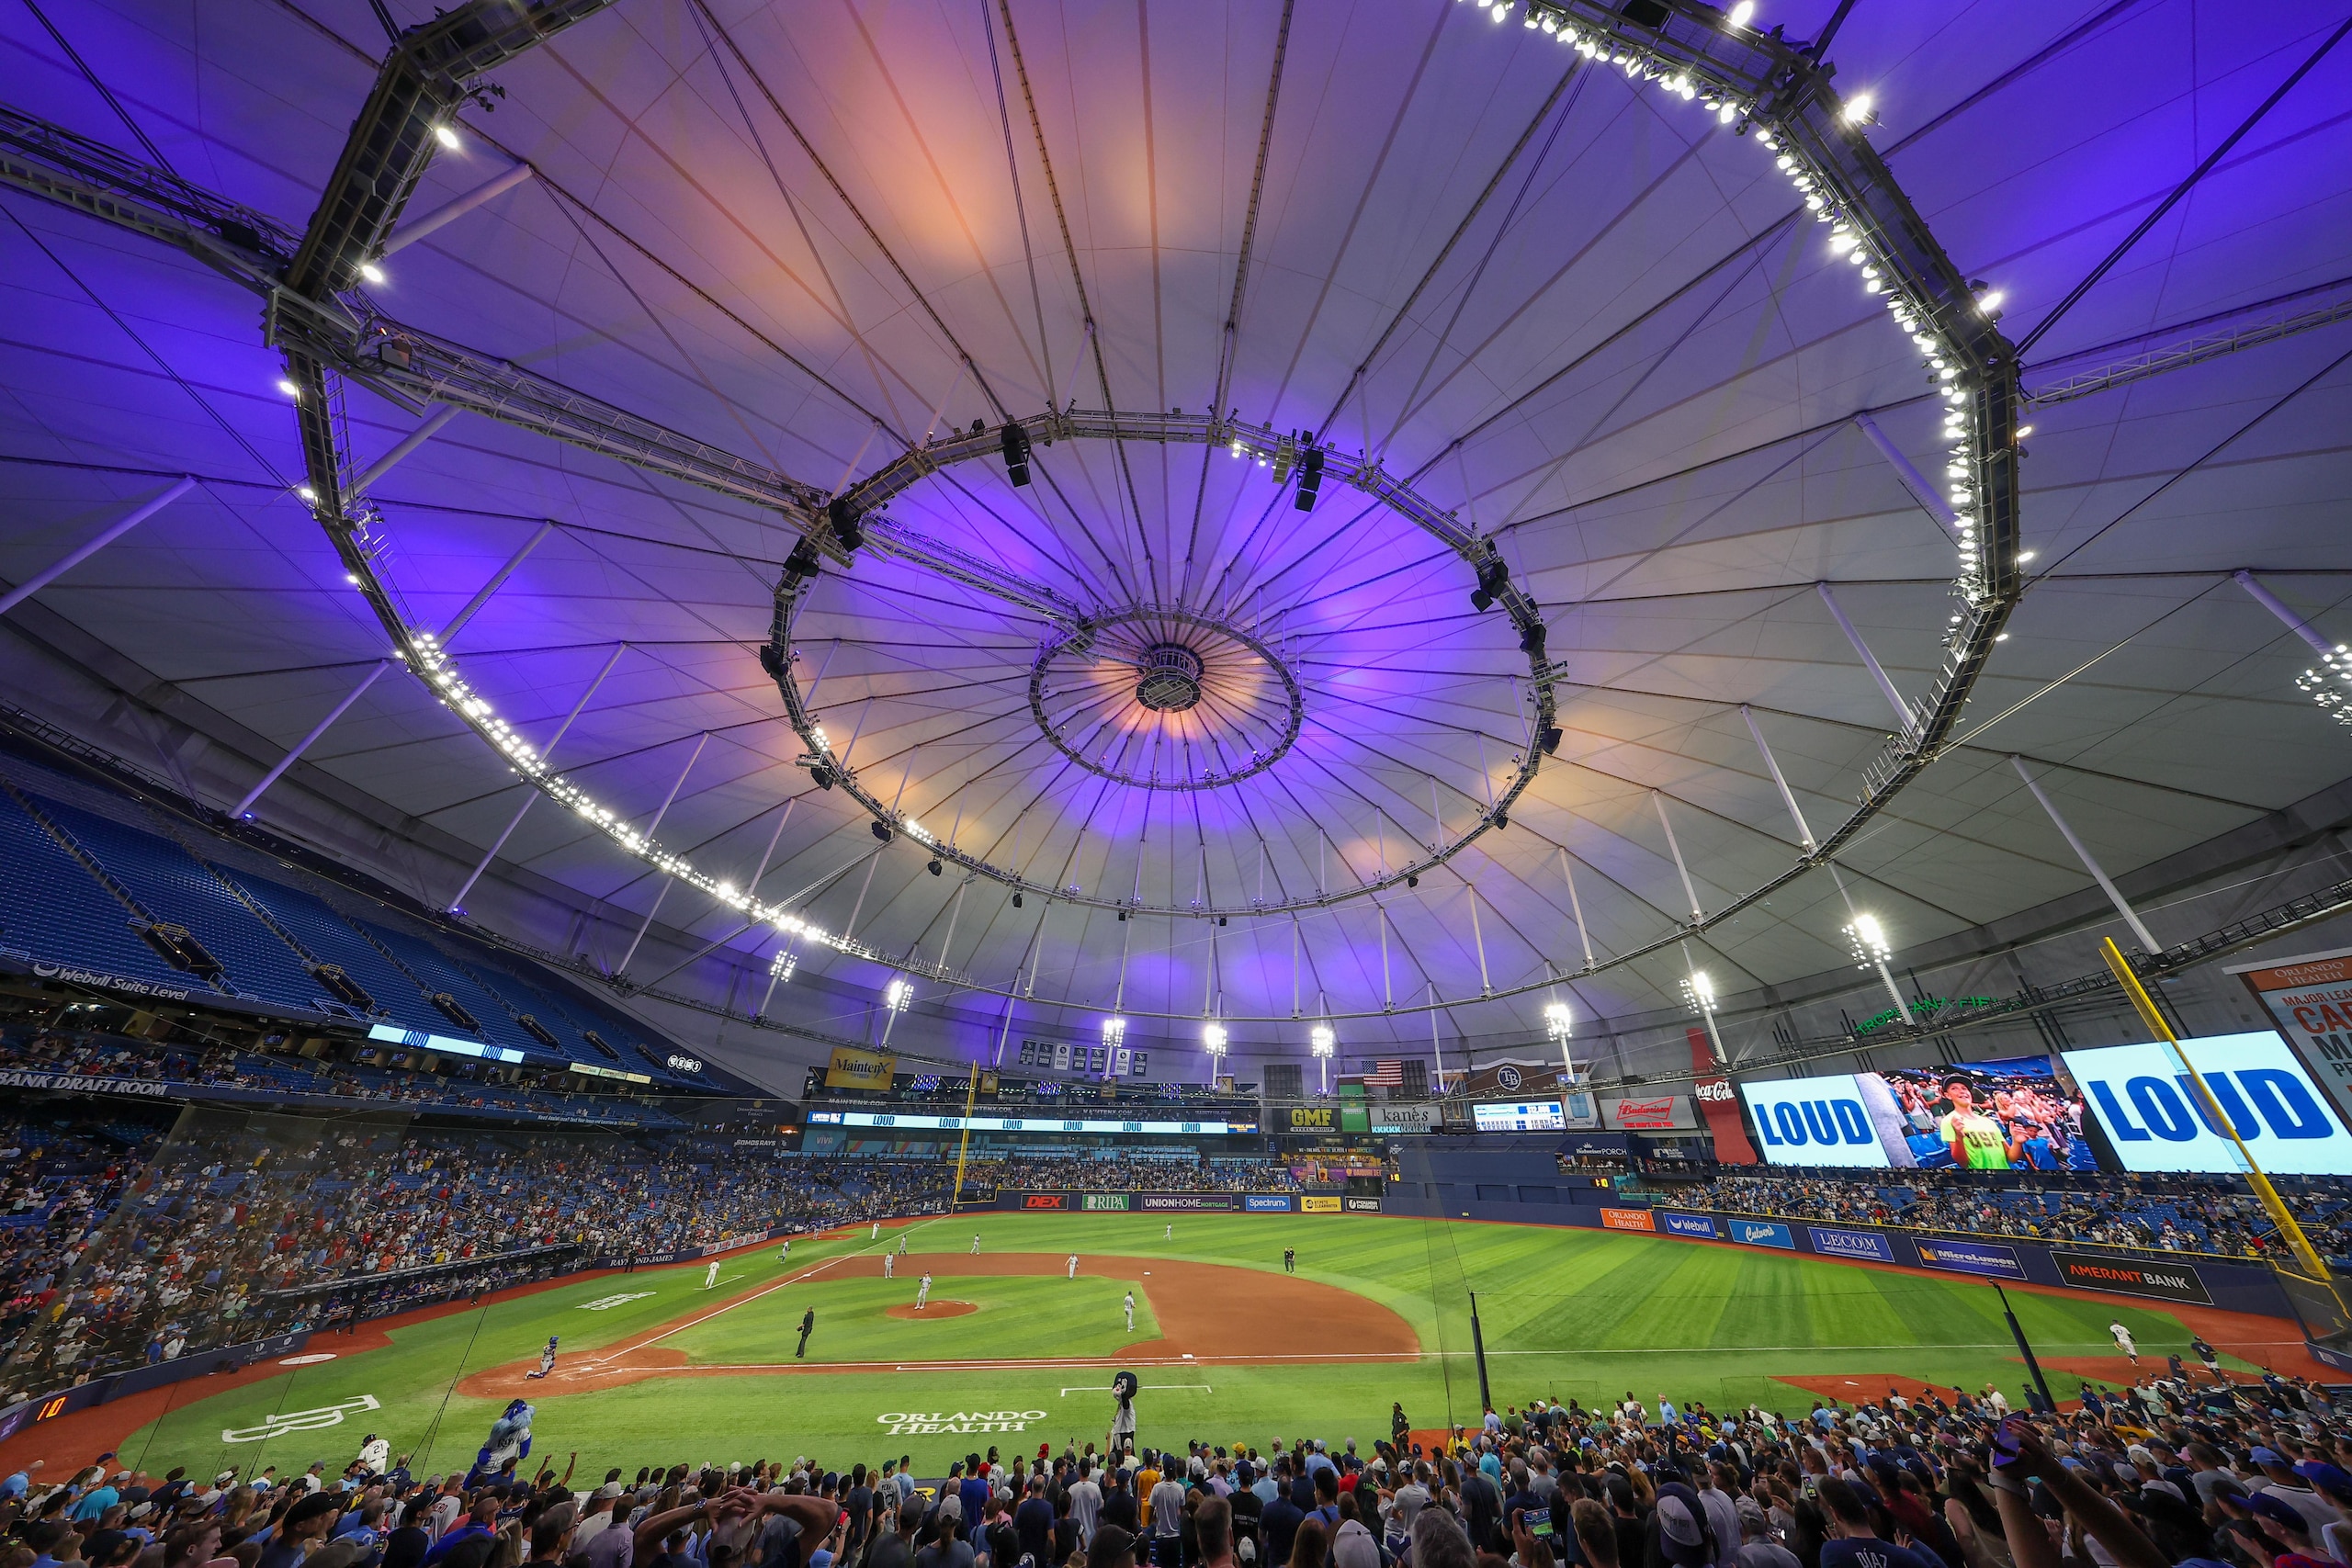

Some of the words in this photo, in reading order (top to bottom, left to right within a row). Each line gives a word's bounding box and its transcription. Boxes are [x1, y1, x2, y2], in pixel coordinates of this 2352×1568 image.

[2274, 961, 2345, 978] ORLANDO
[2287, 971, 2343, 985] HEALTH
[58, 967, 111, 987] Webull
[110, 980, 150, 994] Suite
[151, 987, 189, 1000] Level
[2281, 992, 2326, 1009] MAJOR
[836, 1058, 891, 1079] MaintenX
[51, 1077, 115, 1091] DRAFT
[113, 1081, 168, 1096] ROOM
[1500, 1069, 1520, 1087] TB
[1695, 1081, 1736, 1102] Coca-Cola
[1619, 1105, 1670, 1114] Budweiser
[2086, 1068, 2334, 1142] LOUD
[872, 1115, 895, 1126] LOUD
[939, 1117, 960, 1128] LOUD
[1002, 1120, 1023, 1130] LOUD
[1063, 1121, 1083, 1131] LOUD
[1123, 1122, 1142, 1132] LOUD
[1182, 1122, 1201, 1133] LOUD
[1291, 1109, 1332, 1126] GMF
[1754, 1099, 1873, 1145] LOUD
[1026, 1196, 1063, 1209] DEX
[1097, 1195, 1125, 1210] RIPA
[1249, 1198, 1283, 1209] Spectrum
[1608, 1210, 1646, 1221] ORLANDO
[1614, 1218, 1645, 1229] HEALTH
[1681, 1219, 1712, 1233] Webull
[1937, 1249, 2017, 1266] MicroLumen
[2069, 1264, 2142, 1283] AMERANT
[2142, 1272, 2191, 1290] BANK
[37, 1396, 67, 1421] 10
[876, 1410, 1047, 1424] ORLANDO
[885, 1421, 1026, 1436] HEALTH
[373, 1443, 384, 1454] 21
